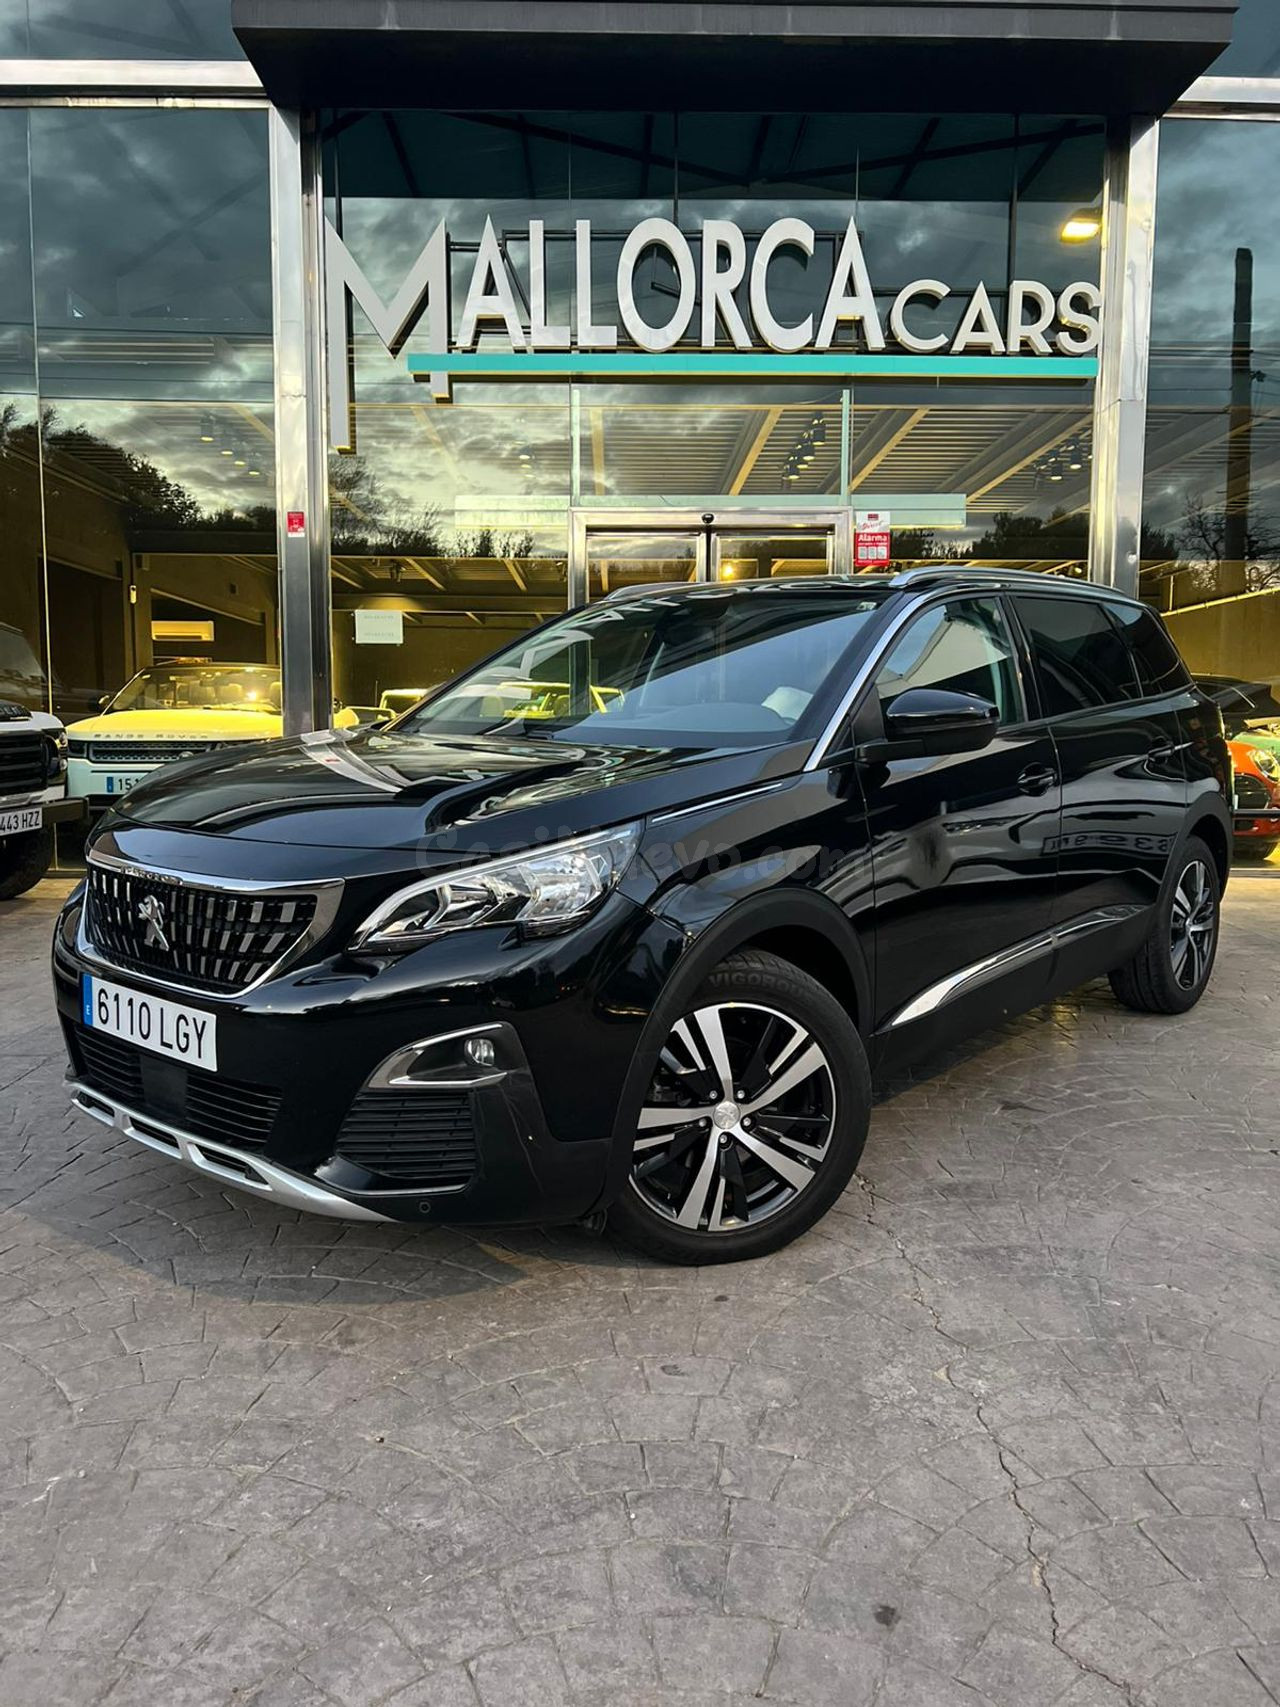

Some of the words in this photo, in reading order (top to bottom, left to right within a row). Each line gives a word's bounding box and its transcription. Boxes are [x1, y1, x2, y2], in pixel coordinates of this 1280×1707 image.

[324, 214, 885, 446] MALLORCA
[890, 280, 1102, 356] CARS
[858, 533, 888, 542] Alarma
[21, 810, 40, 829] HZZ
[98, 987, 151, 1041] 6110
[160, 1007, 207, 1059] LGY
